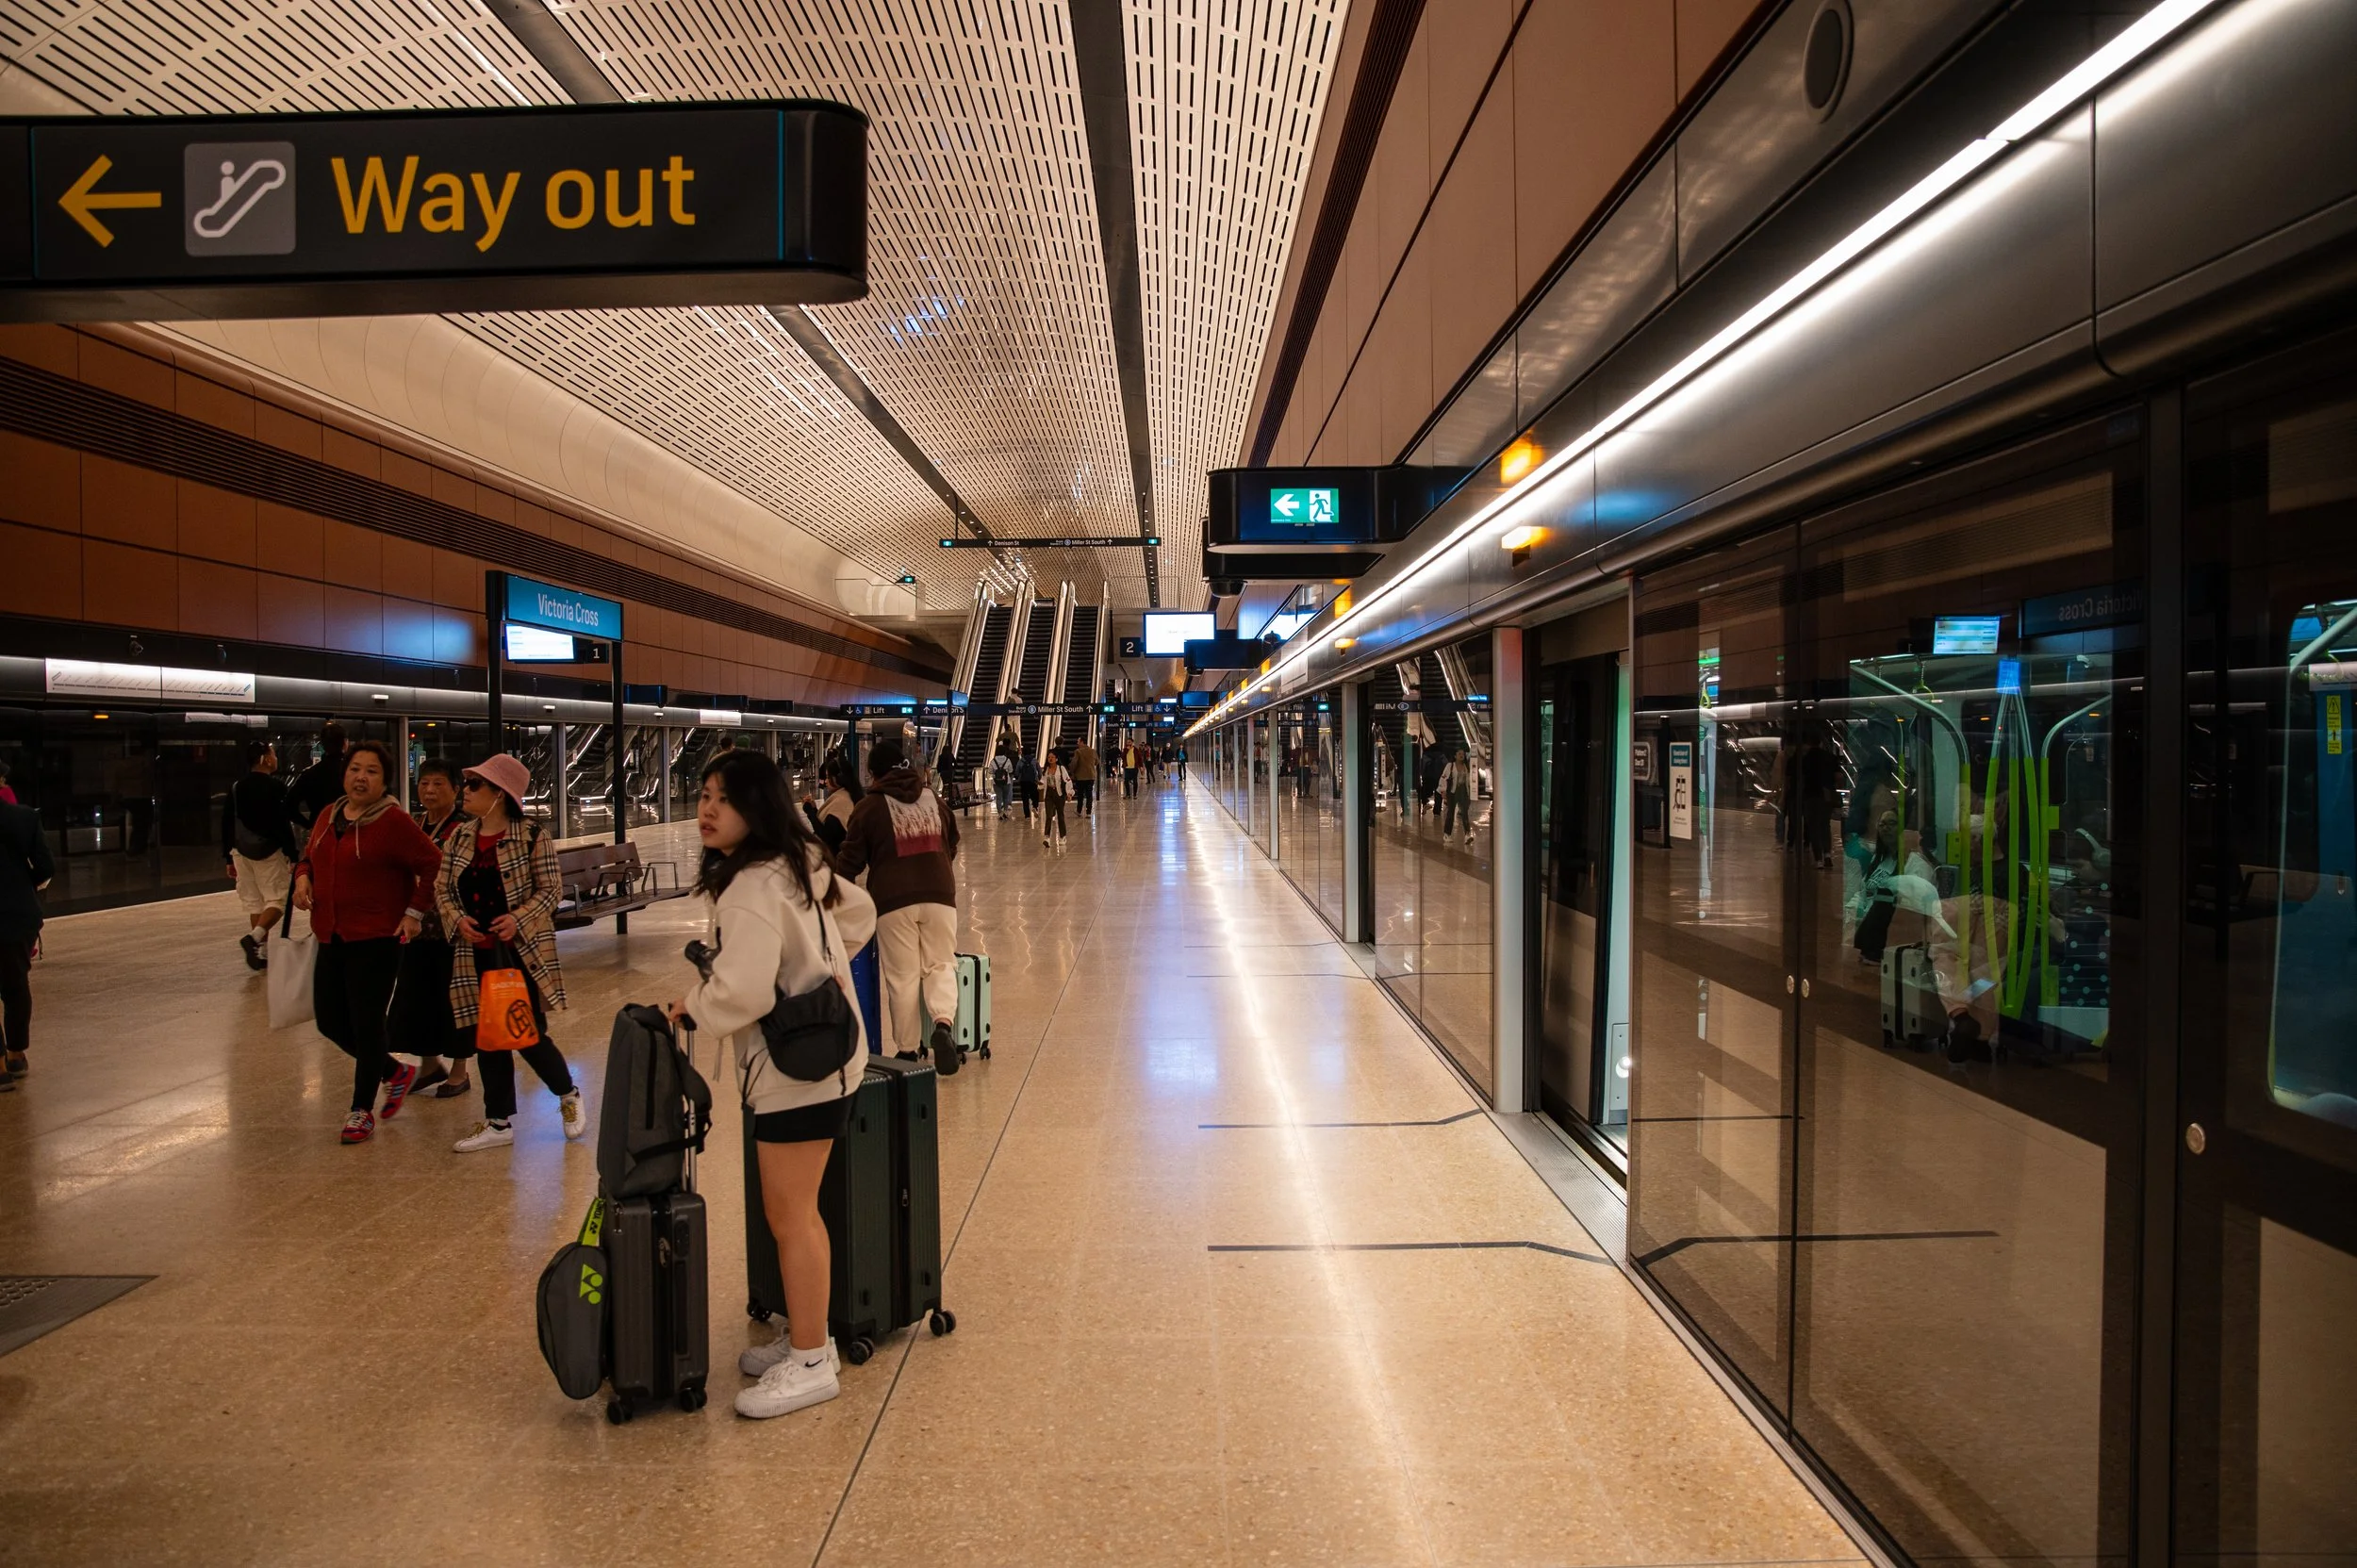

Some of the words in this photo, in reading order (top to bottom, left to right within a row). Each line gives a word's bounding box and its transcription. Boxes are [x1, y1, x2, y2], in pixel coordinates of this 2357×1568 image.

[332, 156, 521, 253] Way
[544, 156, 696, 229] out
[537, 592, 574, 622] Victoria
[575, 602, 599, 627] Cross
[592, 647, 600, 659] 1
[1126, 641, 1134, 652] 2
